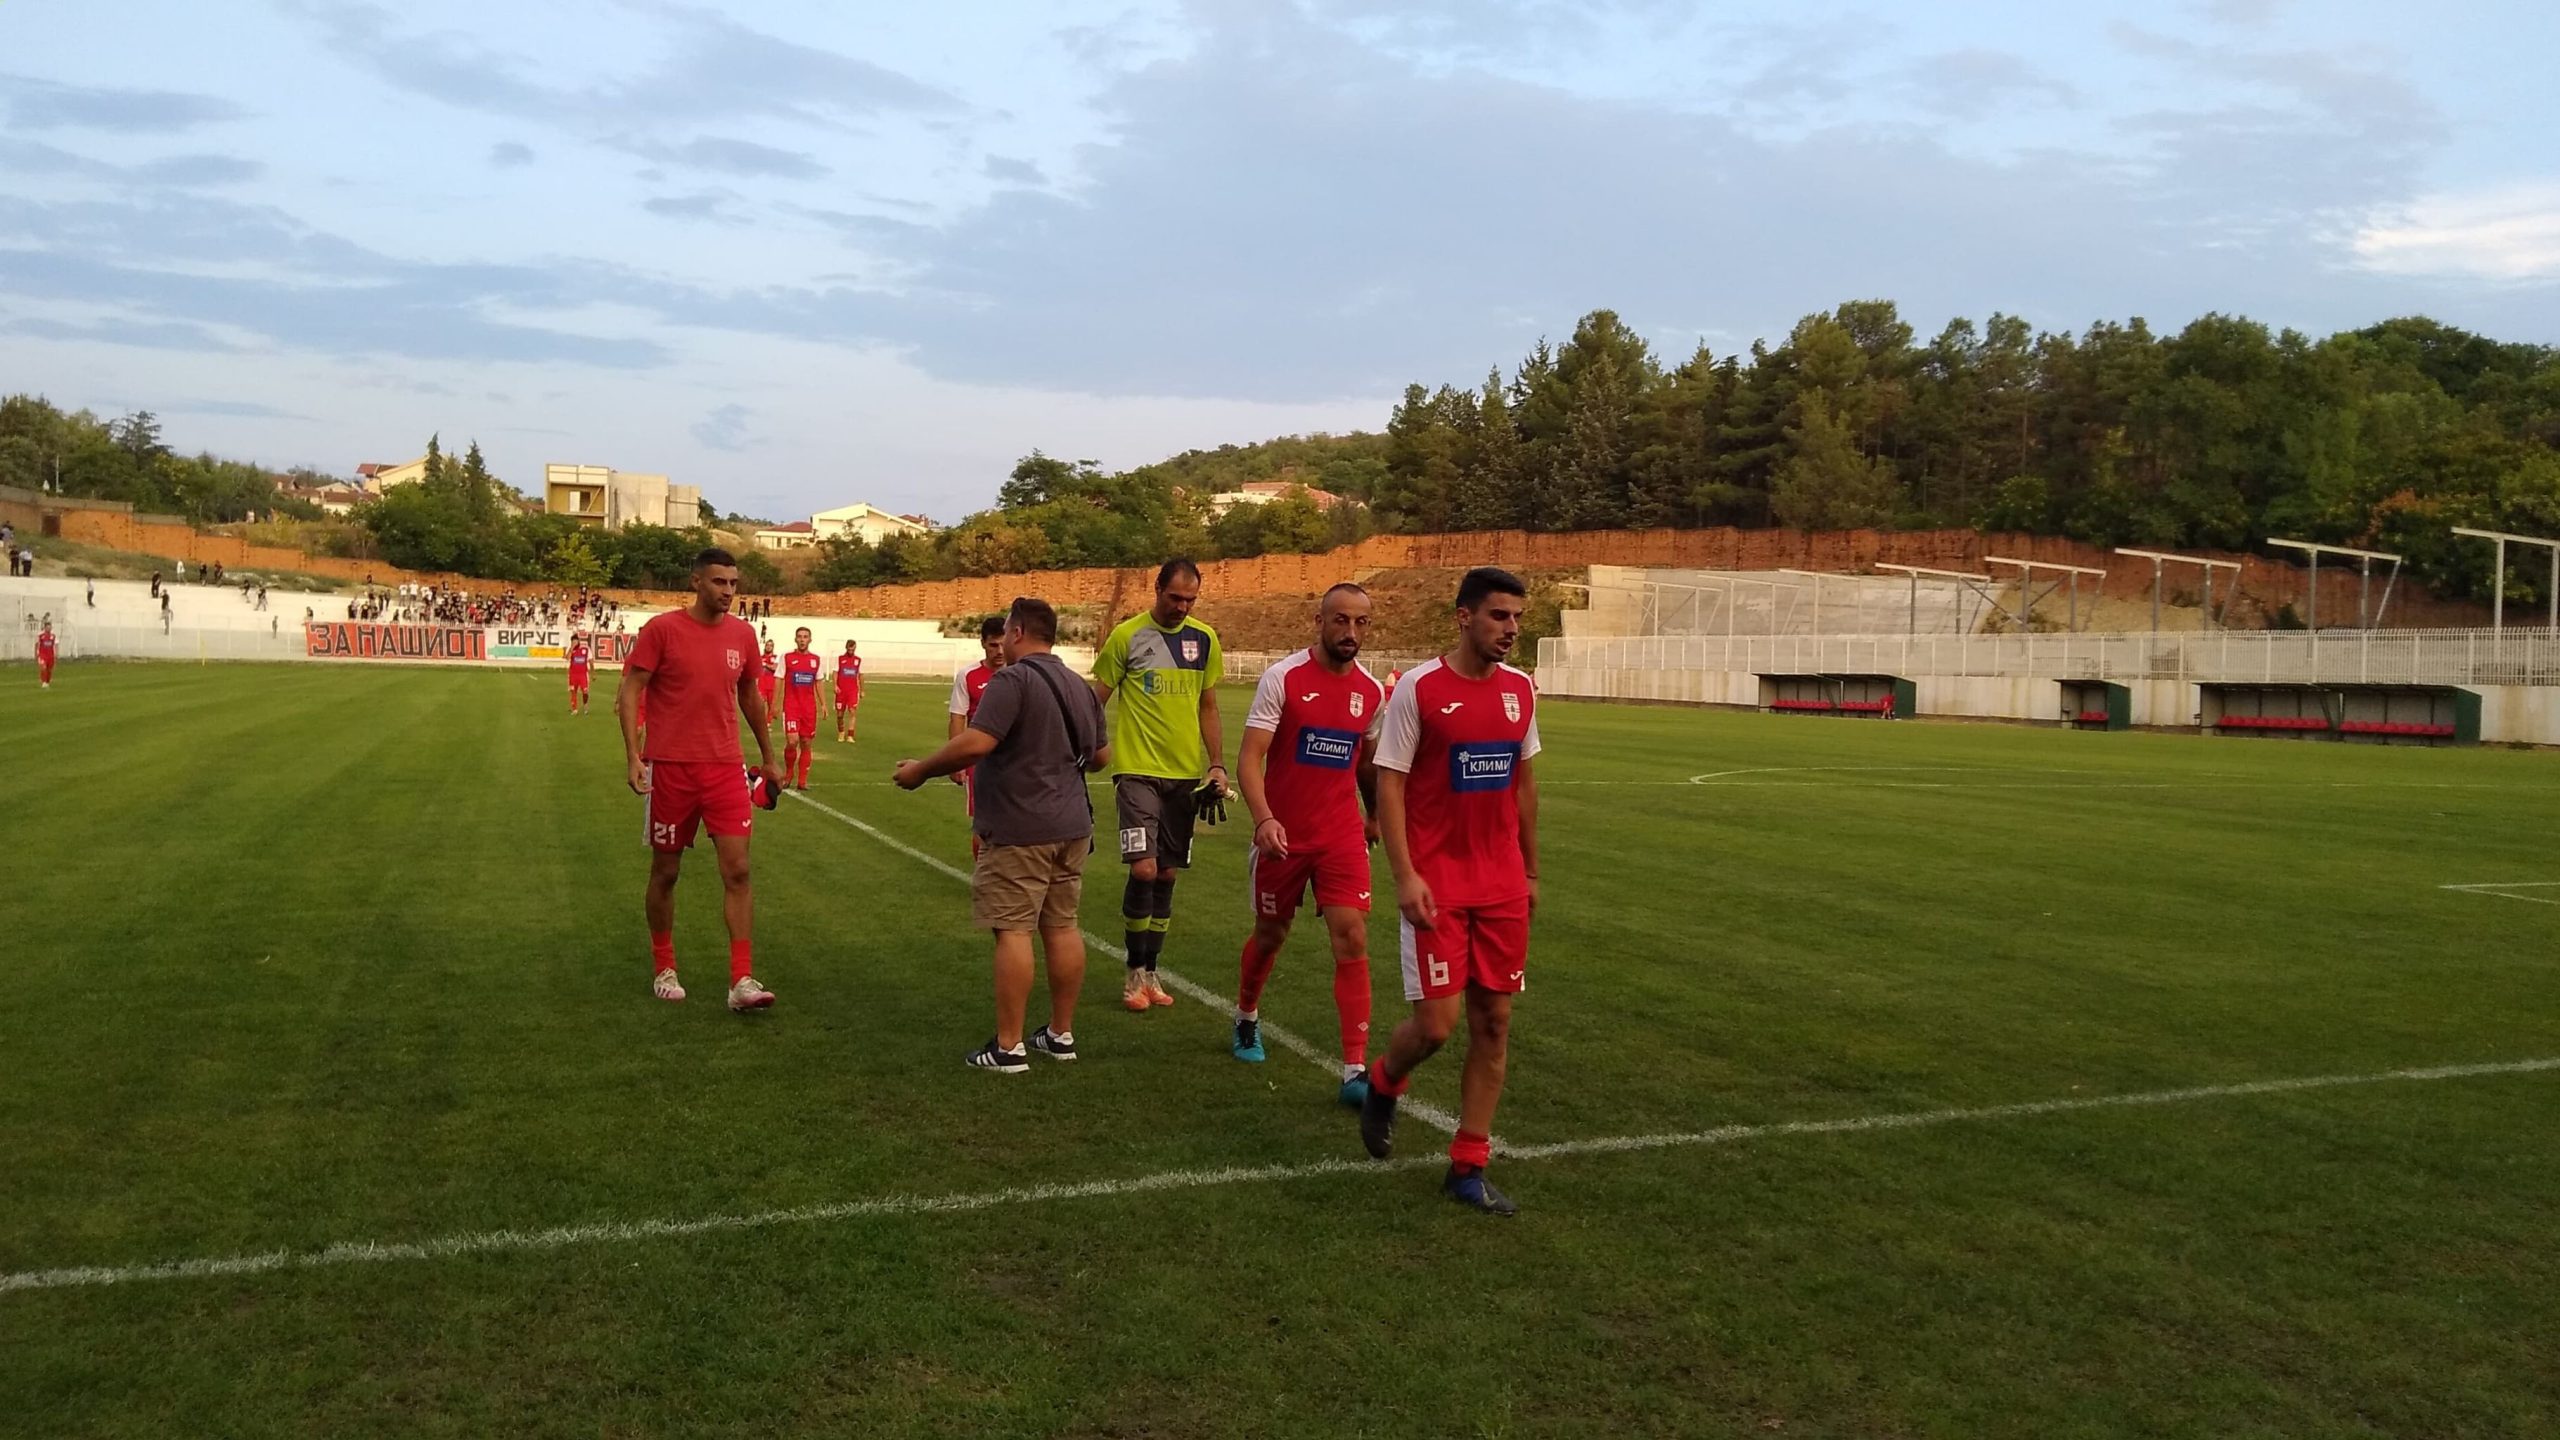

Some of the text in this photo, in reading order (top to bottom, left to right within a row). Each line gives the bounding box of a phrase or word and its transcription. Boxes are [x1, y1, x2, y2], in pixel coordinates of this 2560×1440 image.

[310, 624, 351, 654] ЗА
[357, 625, 484, 658] НАШИОТ
[498, 630, 560, 646] ВИРУС
[1311, 741, 1349, 755] КЛИМИ
[1470, 760, 1511, 773] КЛИМИ
[654, 821, 676, 845] 21
[1121, 828, 1144, 852] 92
[1261, 892, 1277, 915] 5
[1427, 953, 1450, 987] 6
